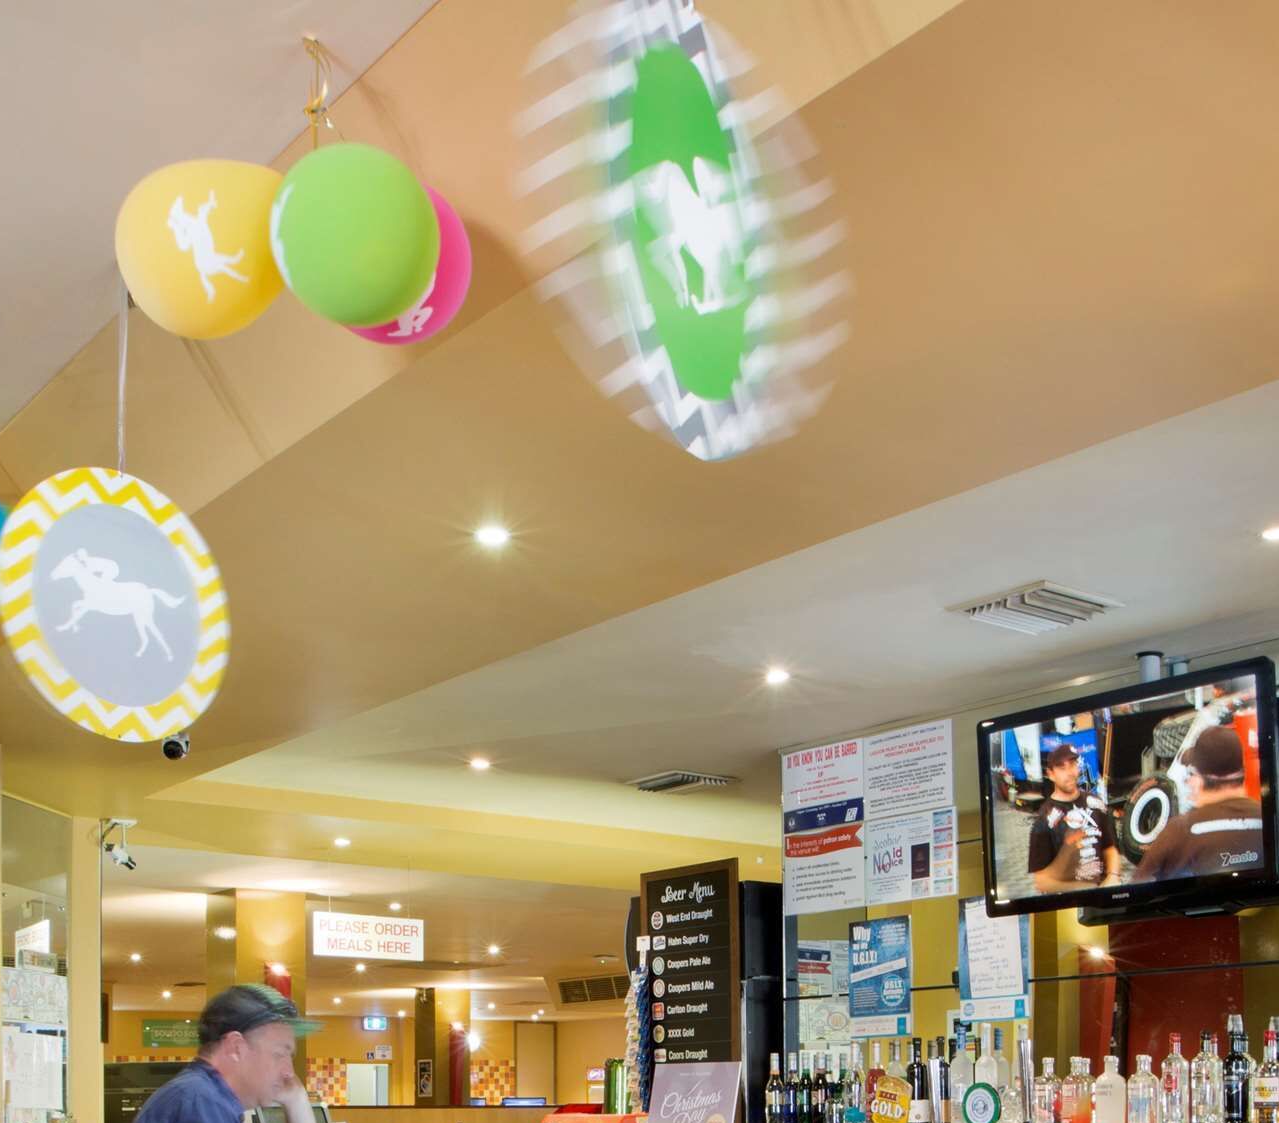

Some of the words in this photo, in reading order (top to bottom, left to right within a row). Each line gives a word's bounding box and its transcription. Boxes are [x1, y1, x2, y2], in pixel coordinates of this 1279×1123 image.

[802, 751, 813, 765] KNOW
[815, 748, 824, 761] YOU
[835, 745, 840, 758] BE
[661, 885, 686, 903] Beer
[689, 882, 716, 903] Menu
[666, 914, 680, 923] West
[681, 912, 690, 921] End
[691, 909, 713, 920] Draught
[320, 919, 369, 934] PLEASE
[374, 922, 419, 937] ORDER
[327, 938, 372, 952] MEALS
[377, 941, 412, 954] HERE
[683, 935, 698, 945] Super
[699, 934, 709, 943] Dry
[667, 960, 688, 969] Coopers
[668, 983, 690, 993] Coopers
[691, 981, 703, 990] Mild
[705, 980, 714, 989] Ale
[687, 1003, 708, 1014] Draught
[682, 1028, 695, 1037] Gold
[685, 1049, 708, 1060] Draught
[661, 1089, 722, 1119] Christmas
[871, 1101, 903, 1119] GOLD
